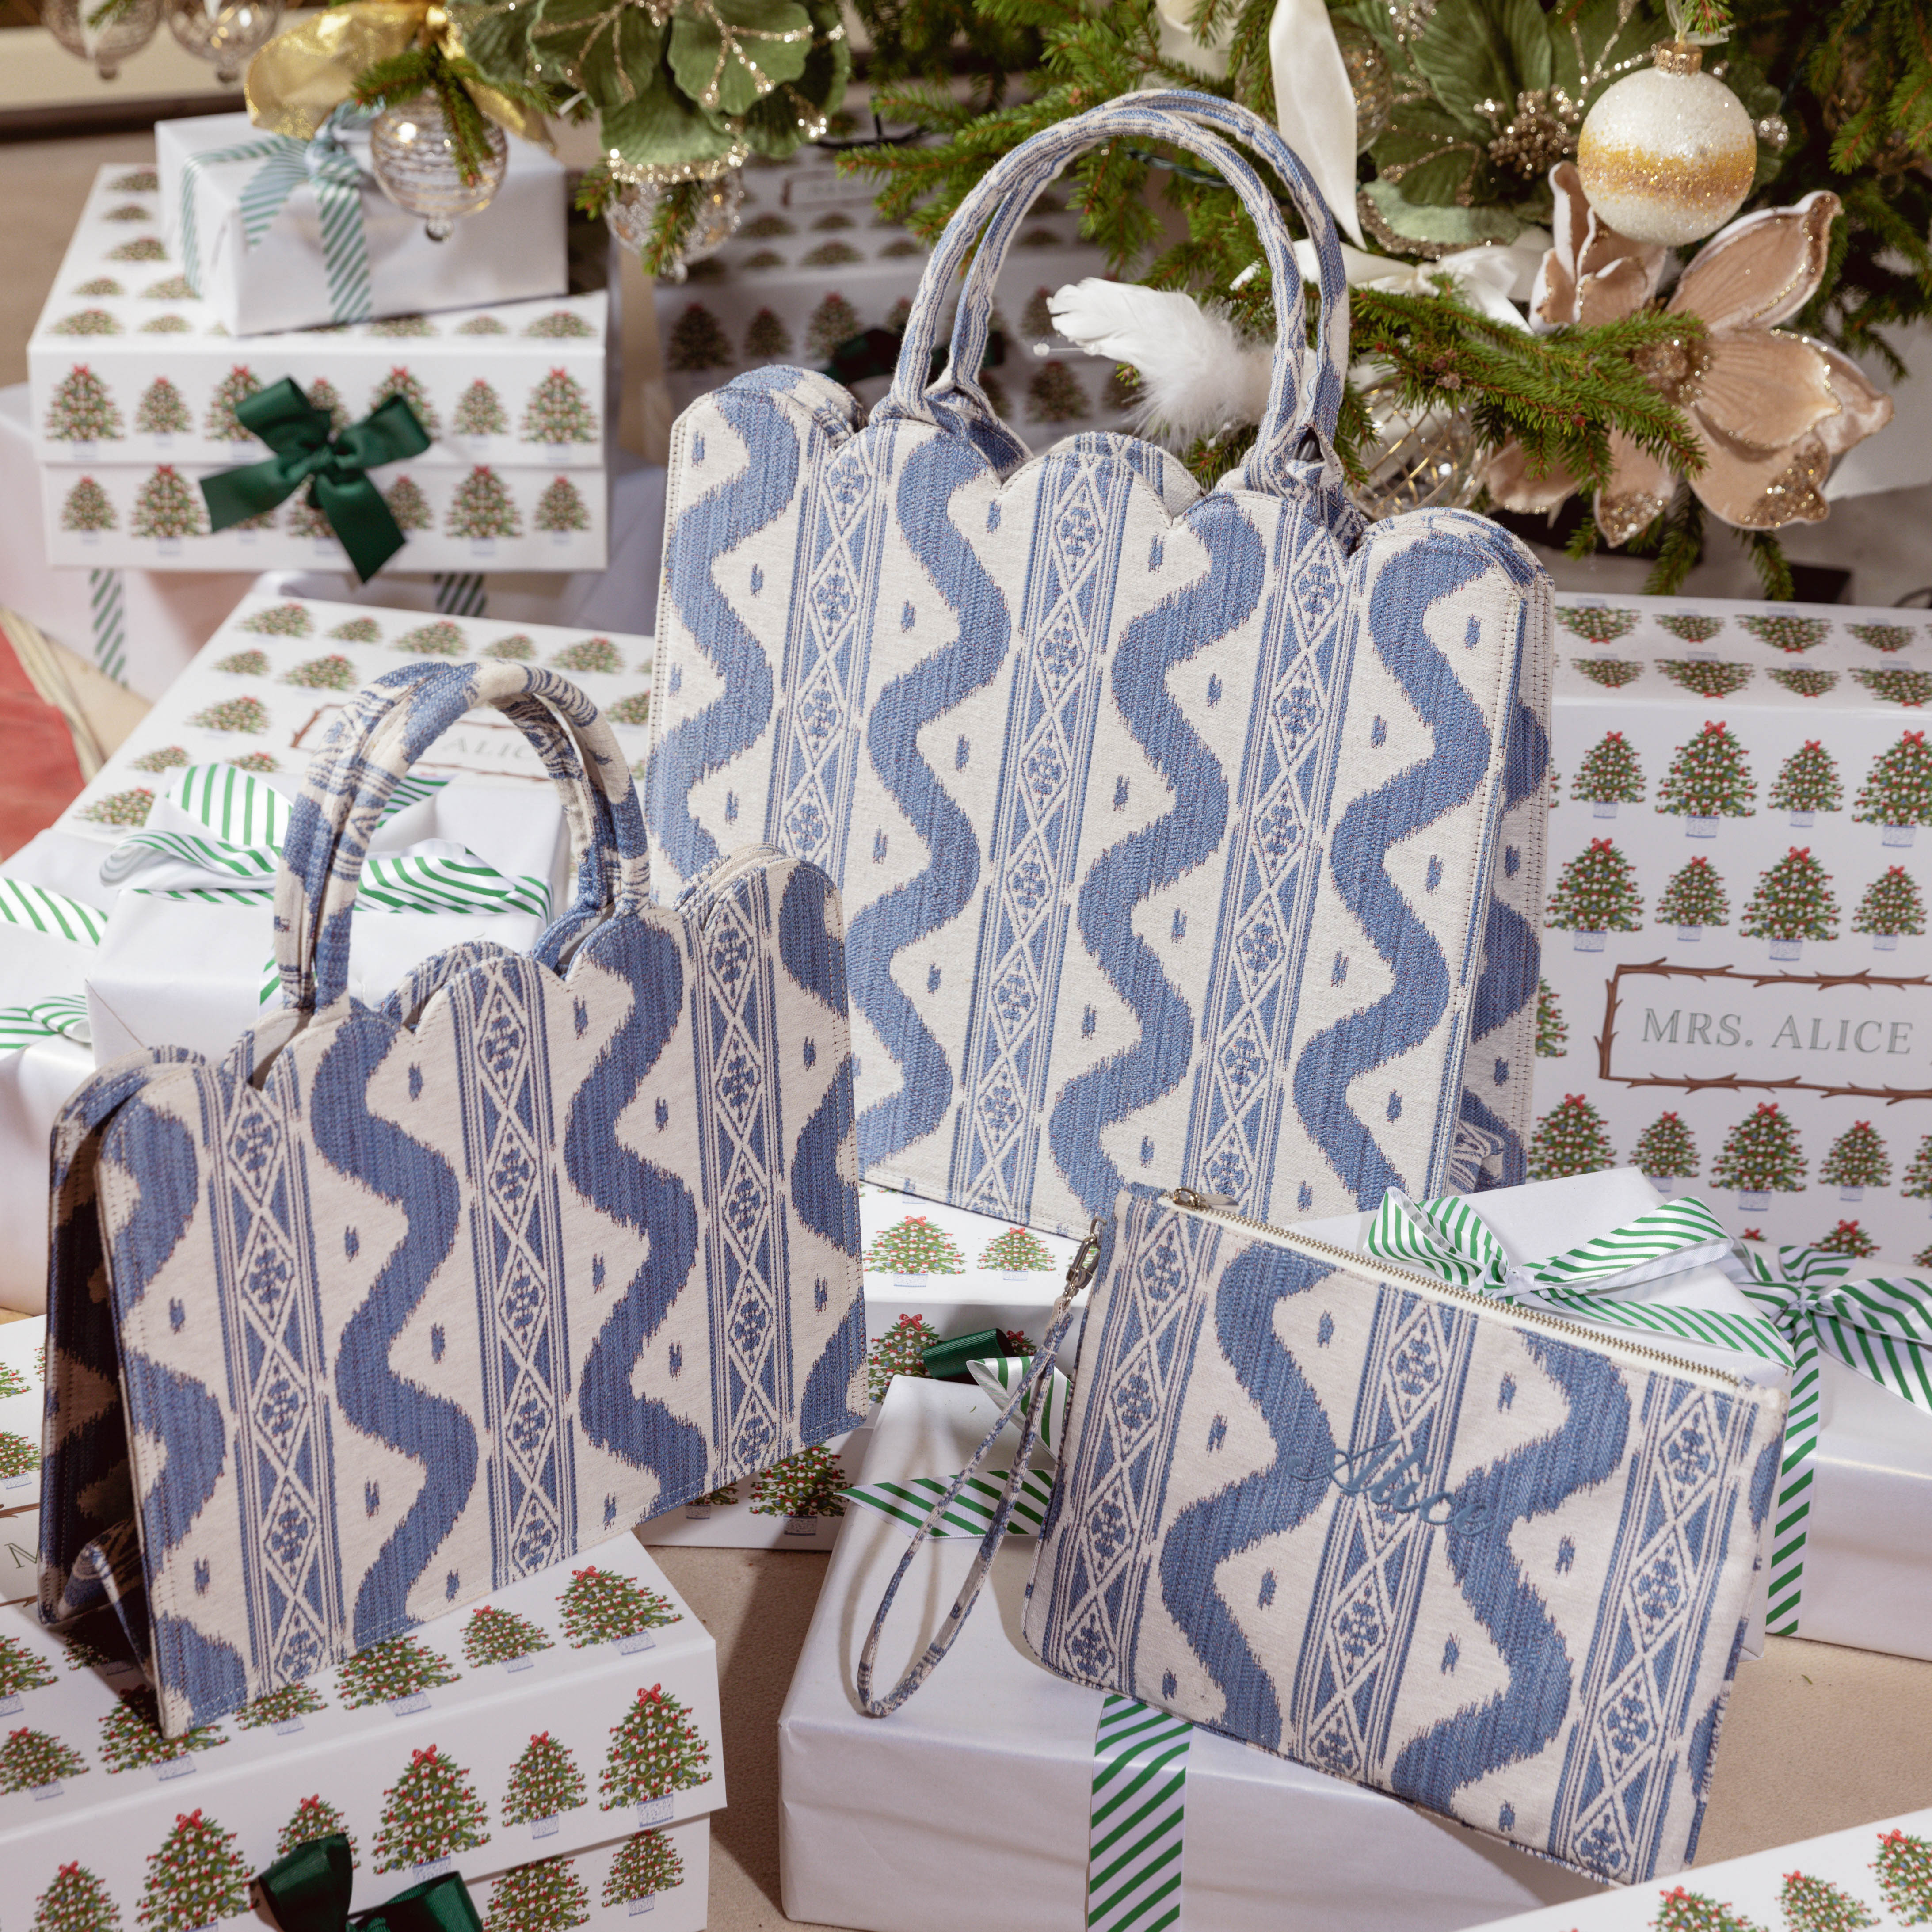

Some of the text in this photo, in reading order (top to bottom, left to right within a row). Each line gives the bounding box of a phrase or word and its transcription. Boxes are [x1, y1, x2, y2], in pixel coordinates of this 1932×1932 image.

[1641, 1008, 1913, 1054] MRS. ALICE
[1287, 1439, 1498, 1536] Alice
